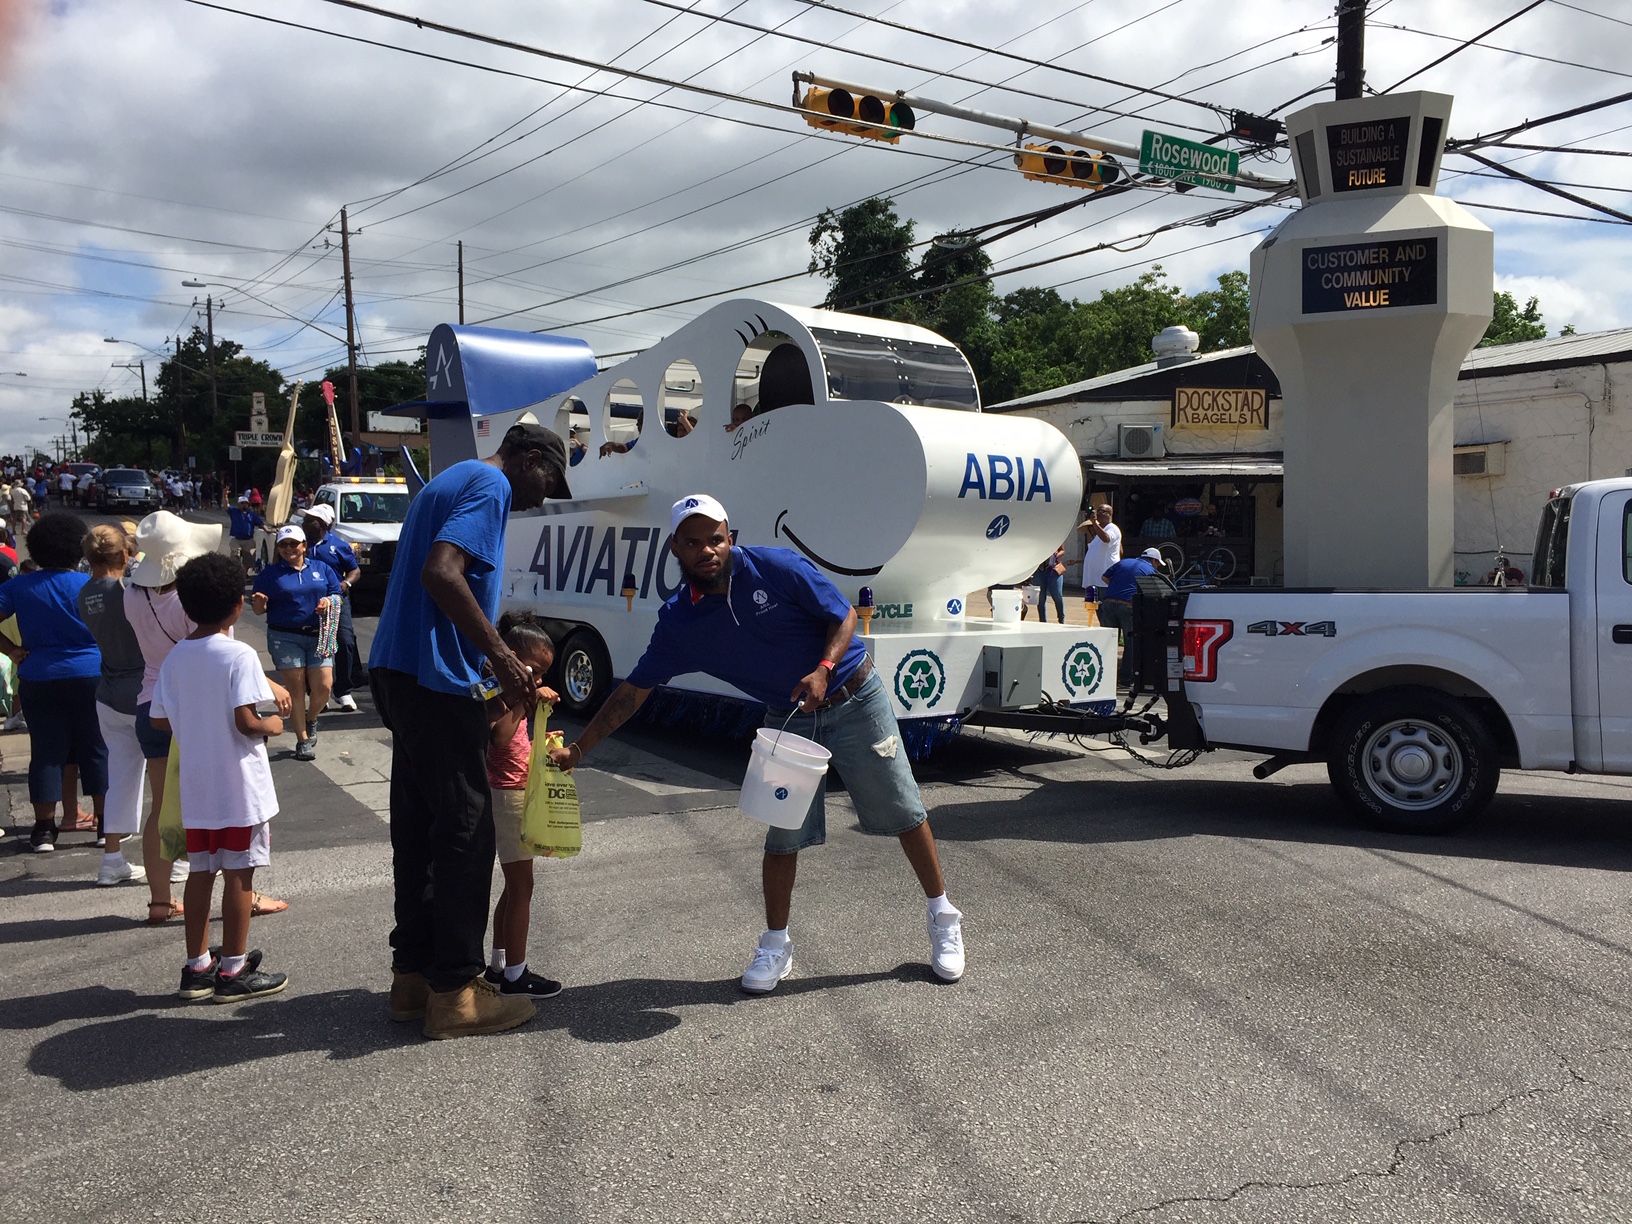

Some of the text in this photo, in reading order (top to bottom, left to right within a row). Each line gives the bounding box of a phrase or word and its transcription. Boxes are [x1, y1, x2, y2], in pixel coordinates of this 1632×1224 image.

[1340, 124, 1396, 145] BUILDING A
[1150, 134, 1231, 175] Rosewood
[1336, 145, 1400, 167] SUSTAINABLE
[1348, 167, 1386, 187] FUTURE
[1307, 244, 1427, 270] CUSTOMER AND
[1321, 266, 1412, 289] COMMUNITY
[1343, 289, 1390, 308] VALUE
[1177, 389, 1264, 424] ROCKSTAR
[1191, 412, 1248, 425] BAGELS
[238, 433, 283, 441] TRIPLE CROWN
[330, 416, 341, 475] AUSTIN
[731, 418, 772, 461] Spirit
[957, 452, 1052, 503] ABIA
[529, 525, 739, 603] AVIATIO
[1347, 721, 1383, 814] WRANGLER
[1438, 714, 1479, 812] GOODYEAR
[548, 788, 565, 799] DG
